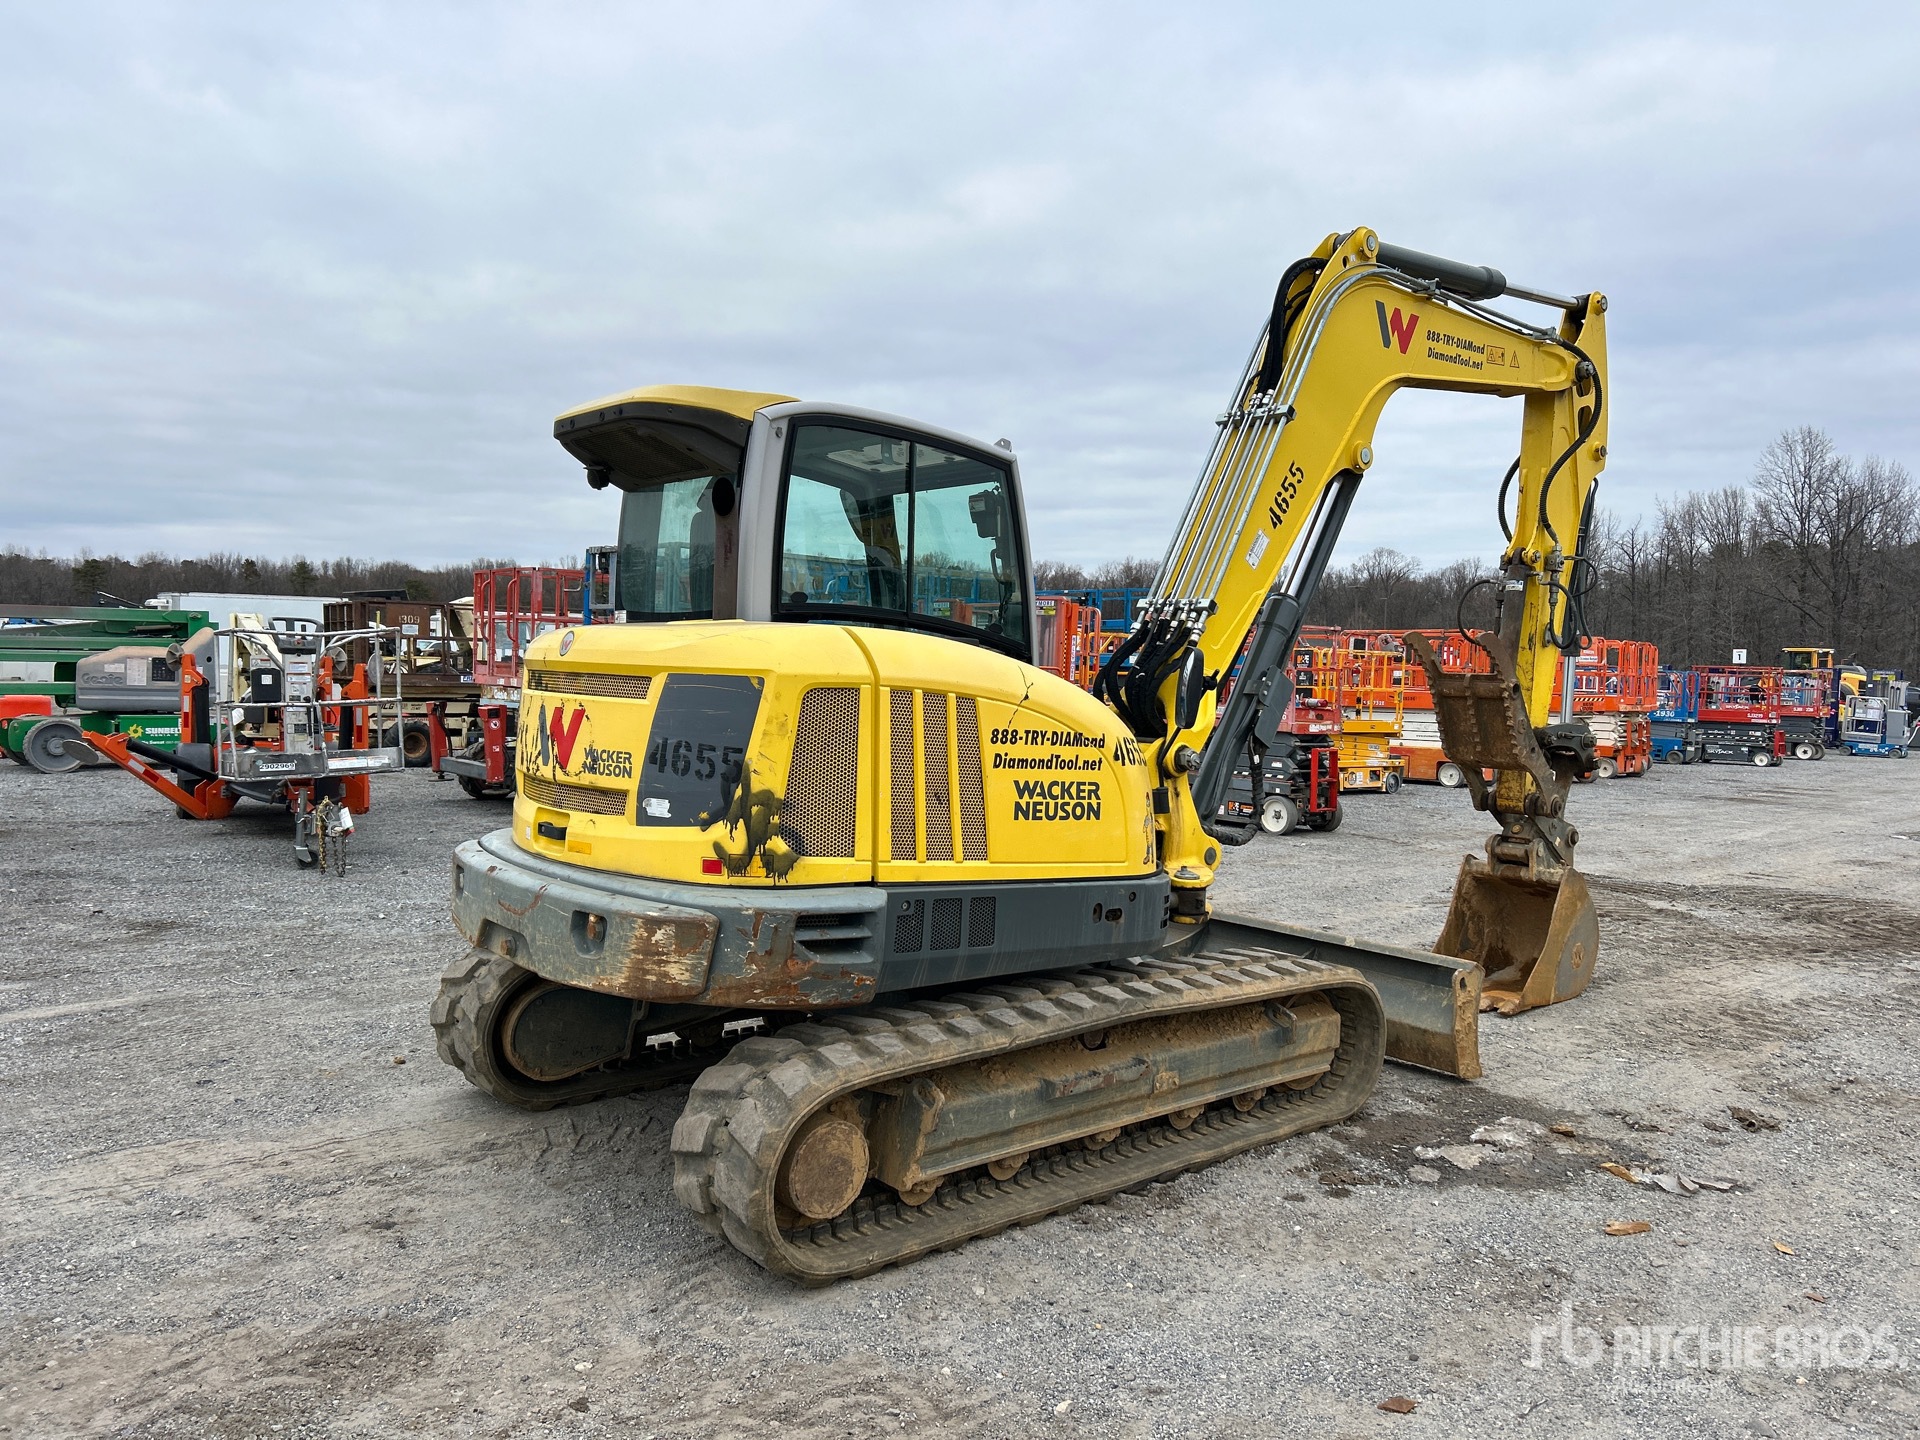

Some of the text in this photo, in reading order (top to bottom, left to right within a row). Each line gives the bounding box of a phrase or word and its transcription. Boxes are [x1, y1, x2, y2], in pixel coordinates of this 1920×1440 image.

[1426, 329, 1486, 355] 888-TRY-DIAMond
[1427, 346, 1484, 370] DiamondTool.net
[1268, 460, 1304, 529] 4655
[990, 728, 1106, 749] 888-TRY-DIAMond
[584, 747, 633, 765] WACKER
[648, 737, 744, 784] 4655
[992, 752, 1103, 771] DiamondTool.net
[582, 760, 633, 779] NEUSON
[1013, 780, 1101, 800] WACKER
[1013, 801, 1101, 821] NEUSON
